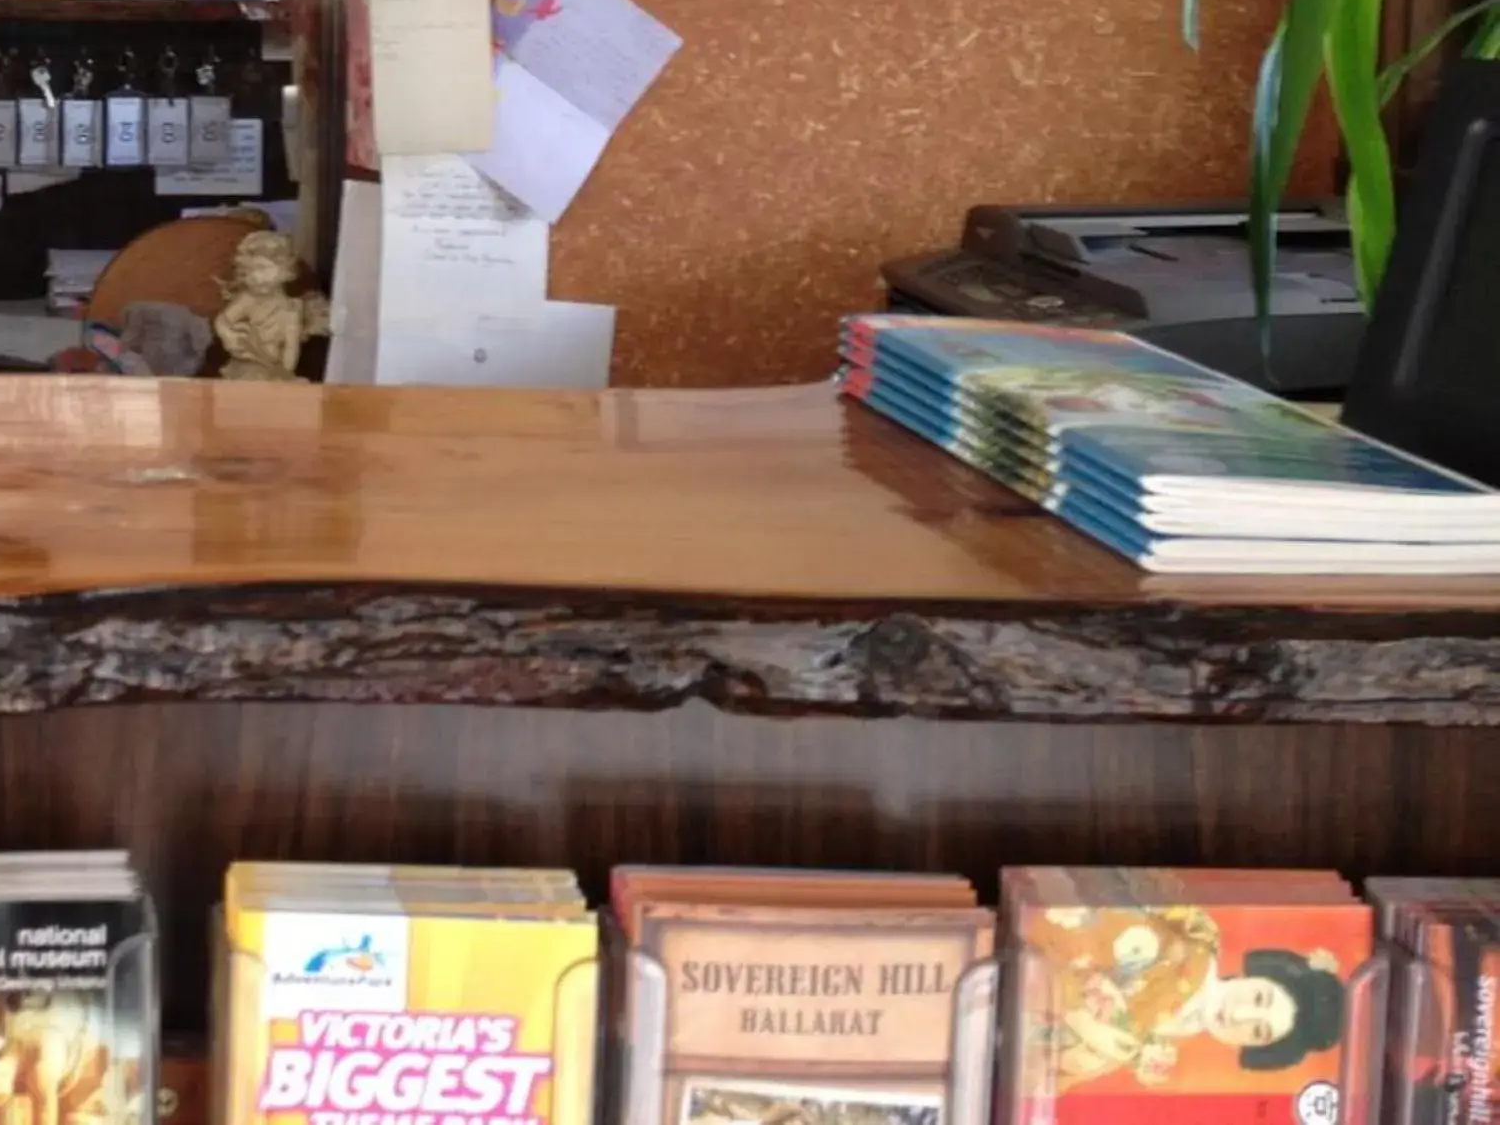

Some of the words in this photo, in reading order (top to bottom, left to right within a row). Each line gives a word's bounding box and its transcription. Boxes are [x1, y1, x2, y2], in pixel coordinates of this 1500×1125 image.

[16, 923, 108, 947] national
[10, 948, 108, 969] museum
[680, 960, 863, 997] SOVEREIGN
[878, 962, 951, 995] HILL
[301, 1011, 516, 1053] VICTORIA'S
[740, 1007, 884, 1036] BALLARAT
[259, 1049, 554, 1114] BIGGEST
